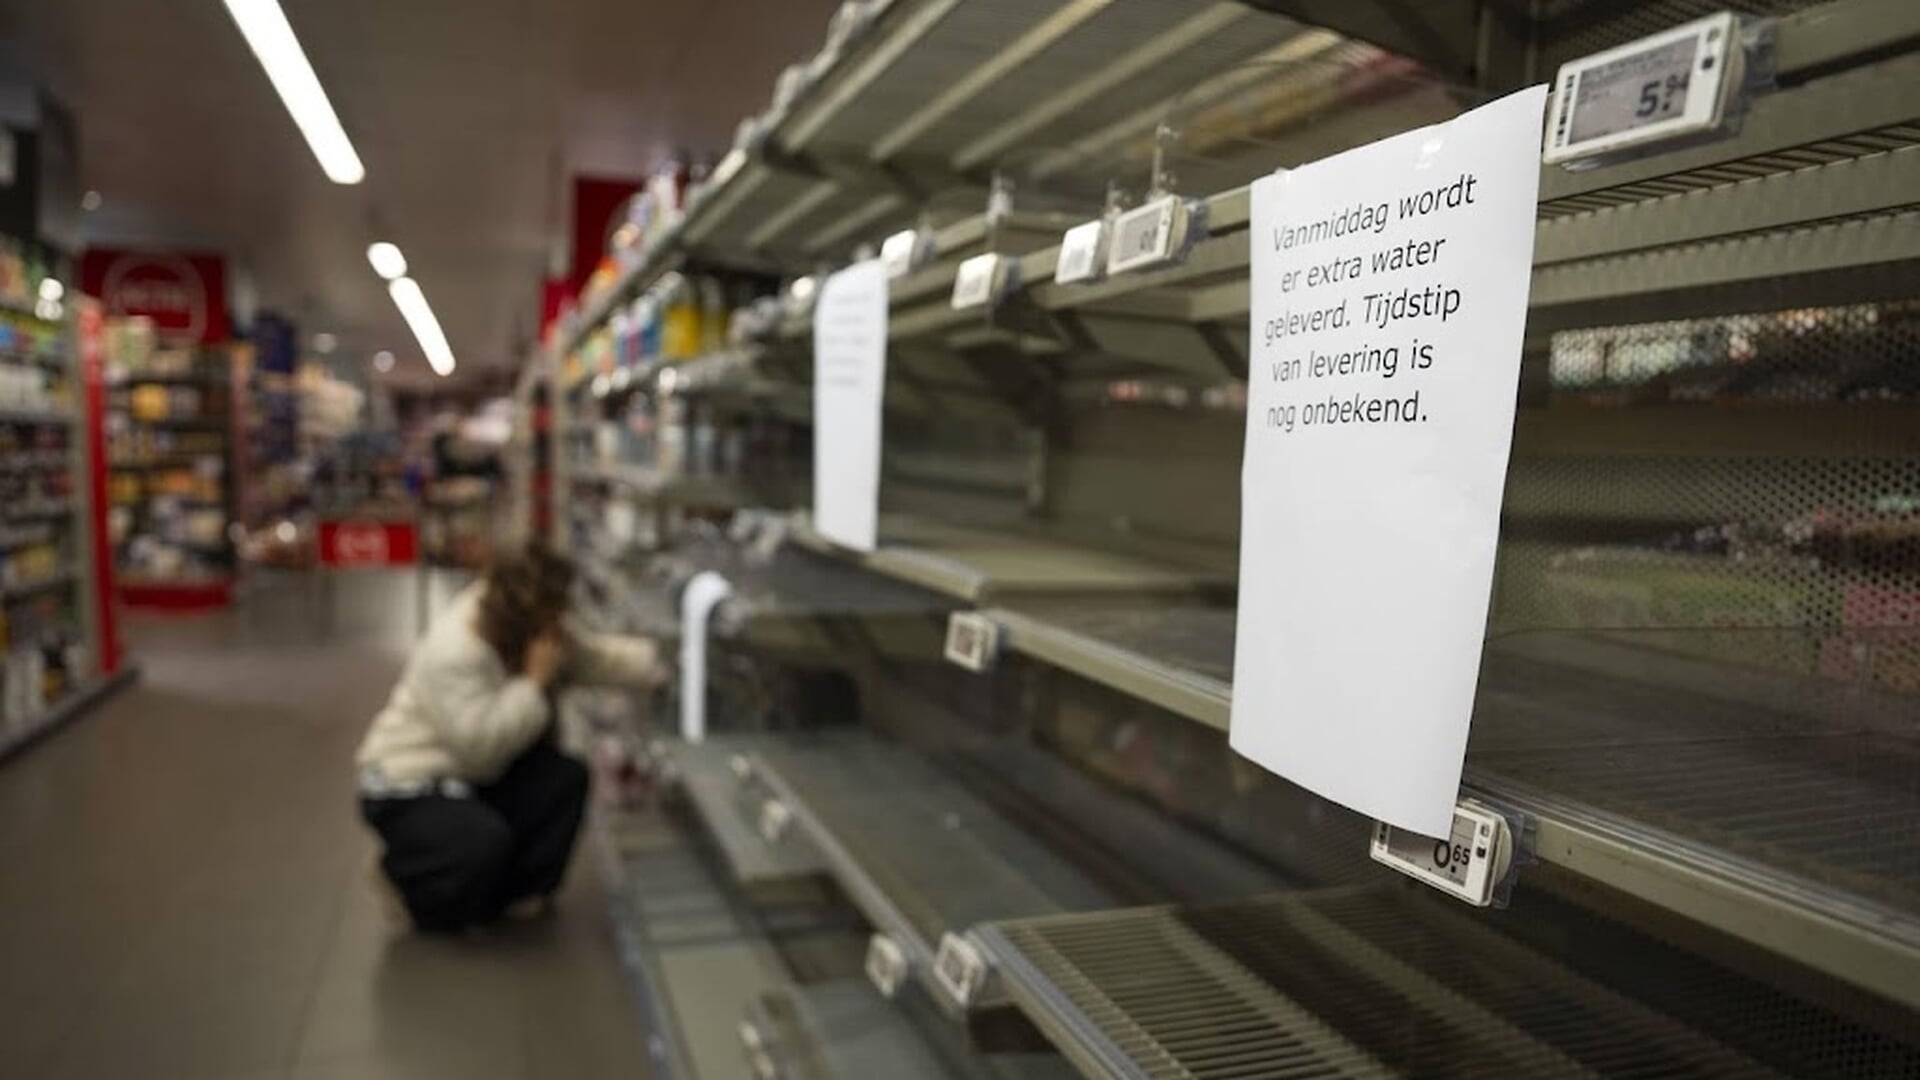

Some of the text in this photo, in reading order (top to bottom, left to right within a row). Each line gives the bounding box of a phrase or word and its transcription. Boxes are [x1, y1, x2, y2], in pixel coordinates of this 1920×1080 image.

[1273, 174, 1477, 252] Vanmiddag wordt
[1281, 238, 1446, 293] er extra water
[1265, 285, 1461, 347] geleverd. Tijdstip
[1272, 339, 1434, 382] van levering is
[1267, 391, 1428, 433] nog onbekend.
